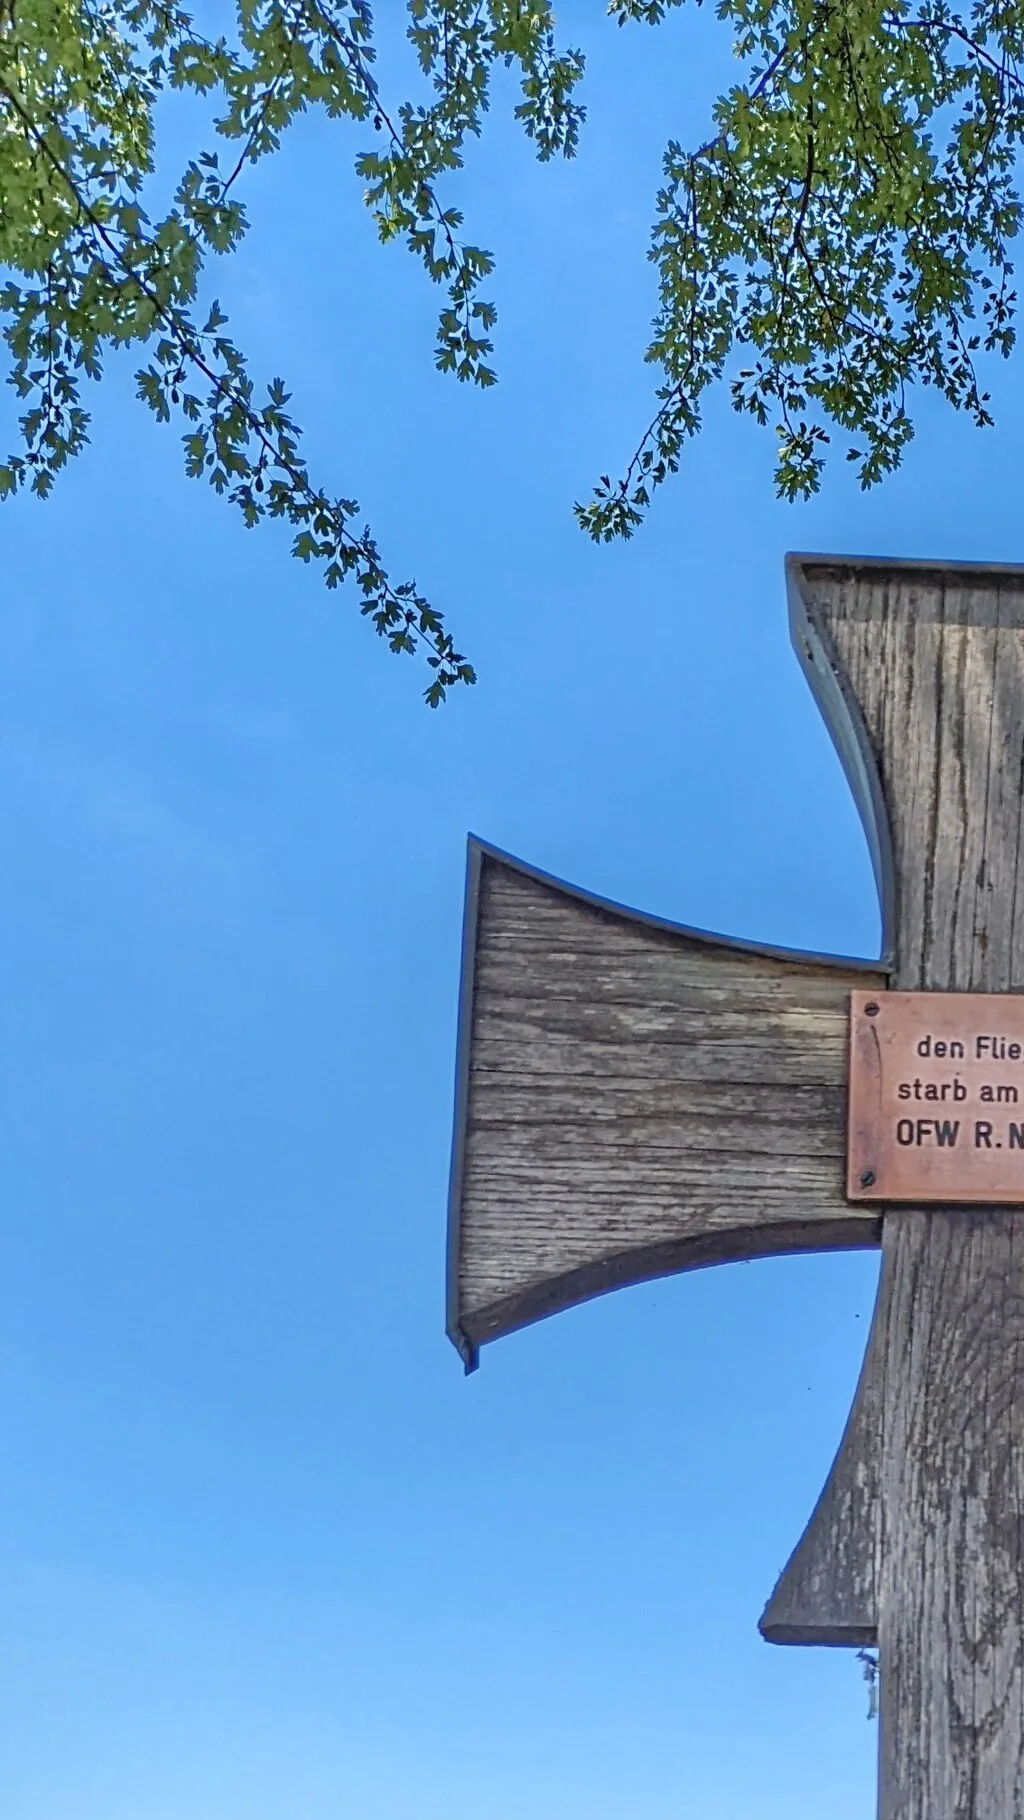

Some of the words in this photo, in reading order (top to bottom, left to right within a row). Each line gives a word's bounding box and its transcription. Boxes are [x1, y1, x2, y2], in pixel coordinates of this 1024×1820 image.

[917, 1035, 964, 1059] den
[898, 1078, 967, 1101] starb
[980, 1085, 1018, 1103] am
[896, 1119, 960, 1147] OFW
